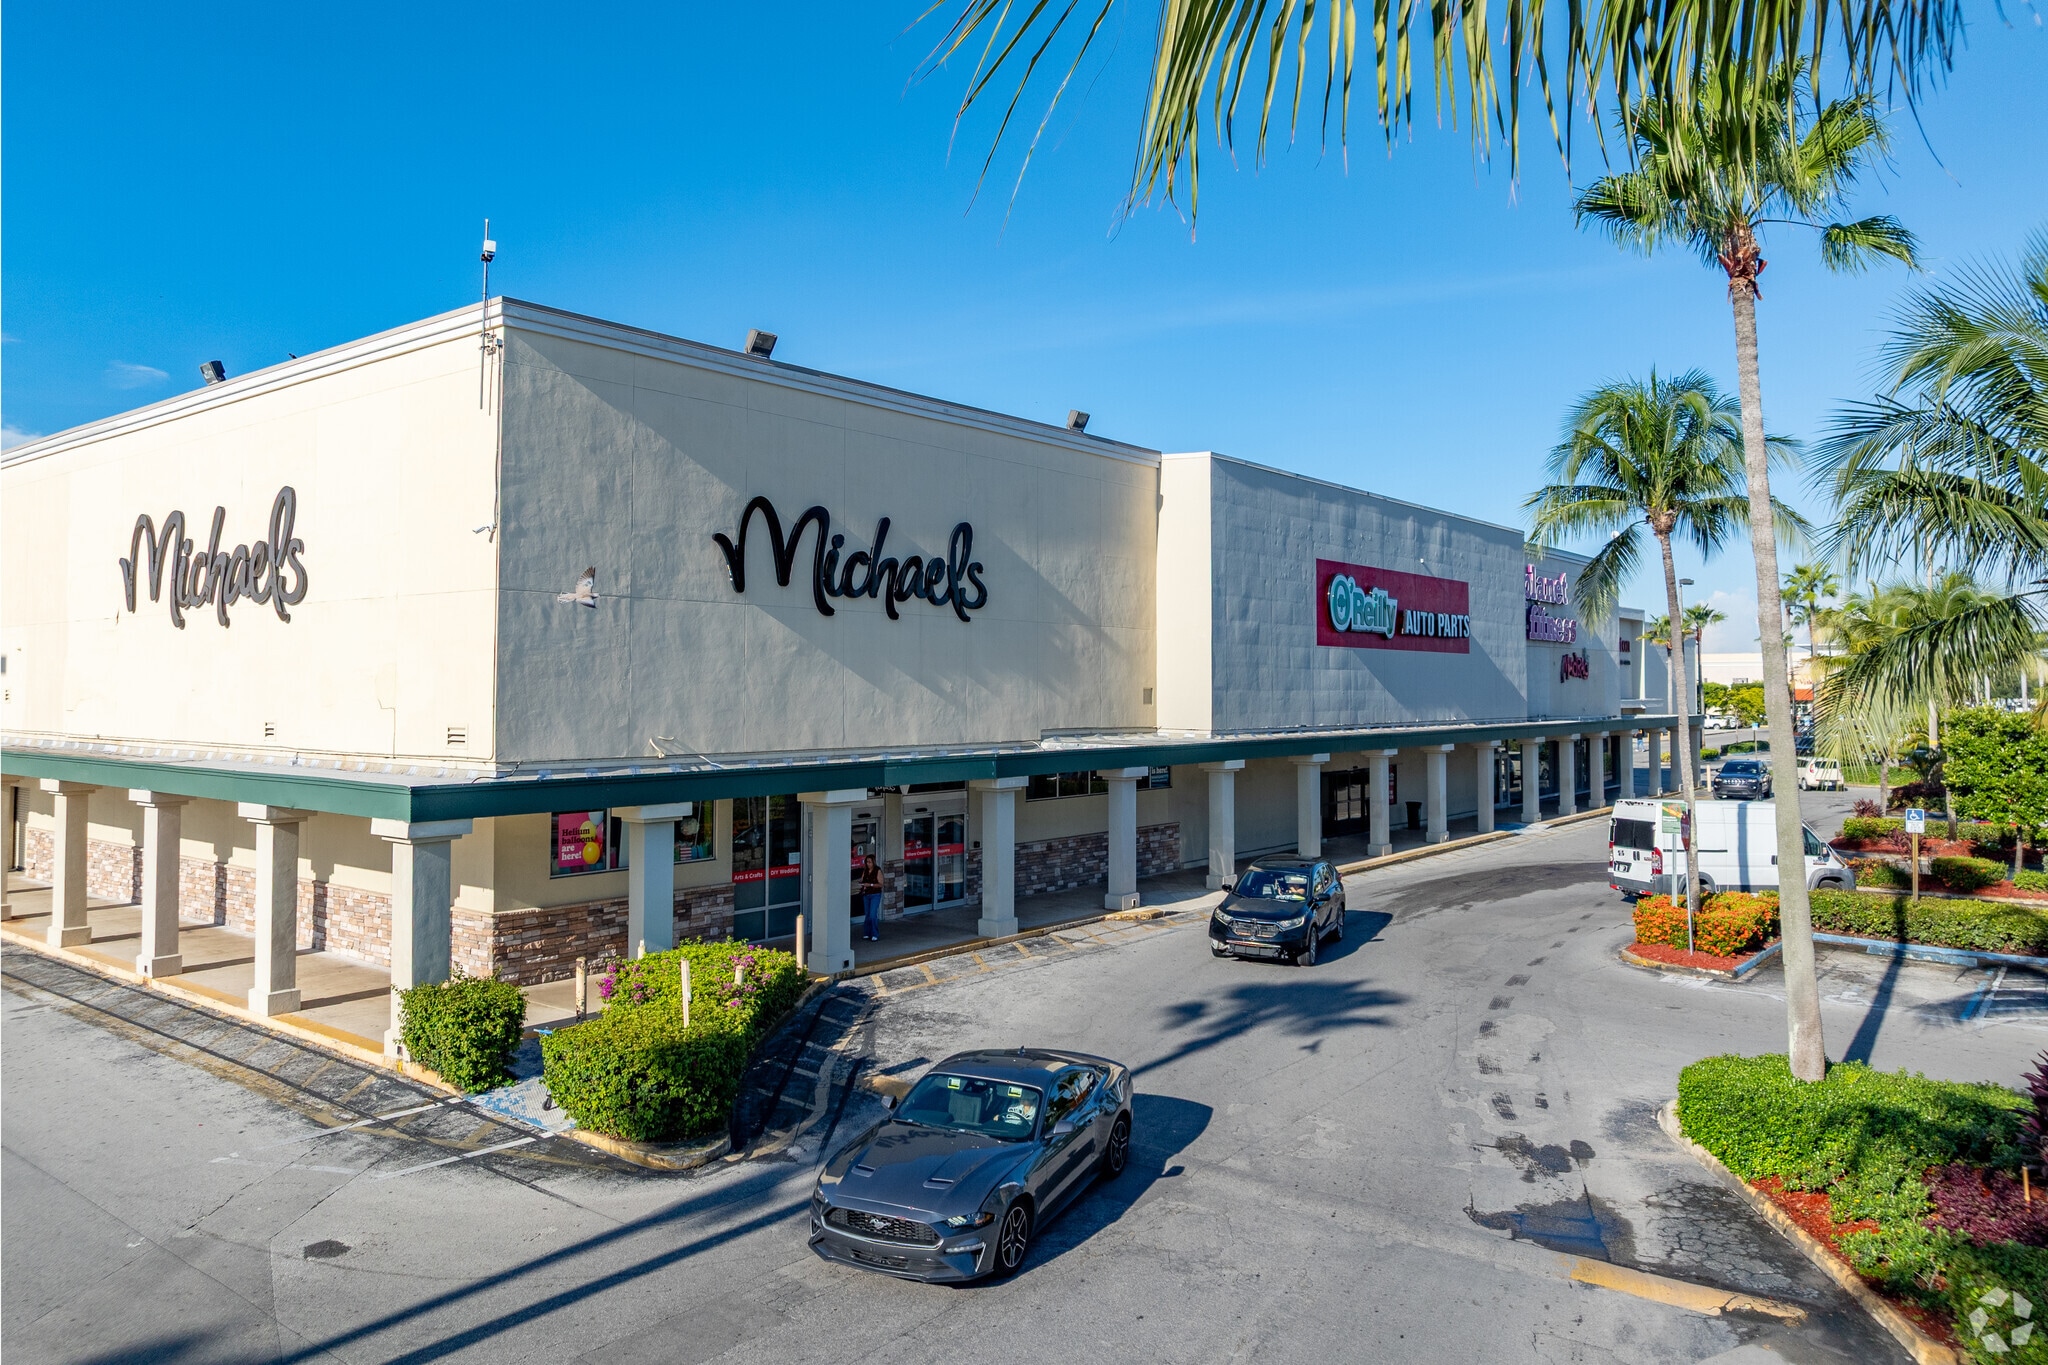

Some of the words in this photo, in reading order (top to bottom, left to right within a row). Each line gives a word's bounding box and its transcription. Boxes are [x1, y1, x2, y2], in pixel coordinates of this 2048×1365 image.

[118, 486, 308, 630] Michaels
[712, 496, 988, 622] Michaels
[1329, 573, 1398, 639] O'Reilly
[1404, 609, 1435, 637] AUTO
[1438, 612, 1470, 638] PARTS
[1530, 605, 1577, 643] fitness
[562, 828, 590, 836] Helium
[562, 836, 595, 844] balloons
[562, 851, 582, 860] here!
[749, 871, 763, 879] Crafts
[780, 867, 800, 875] Wedding
